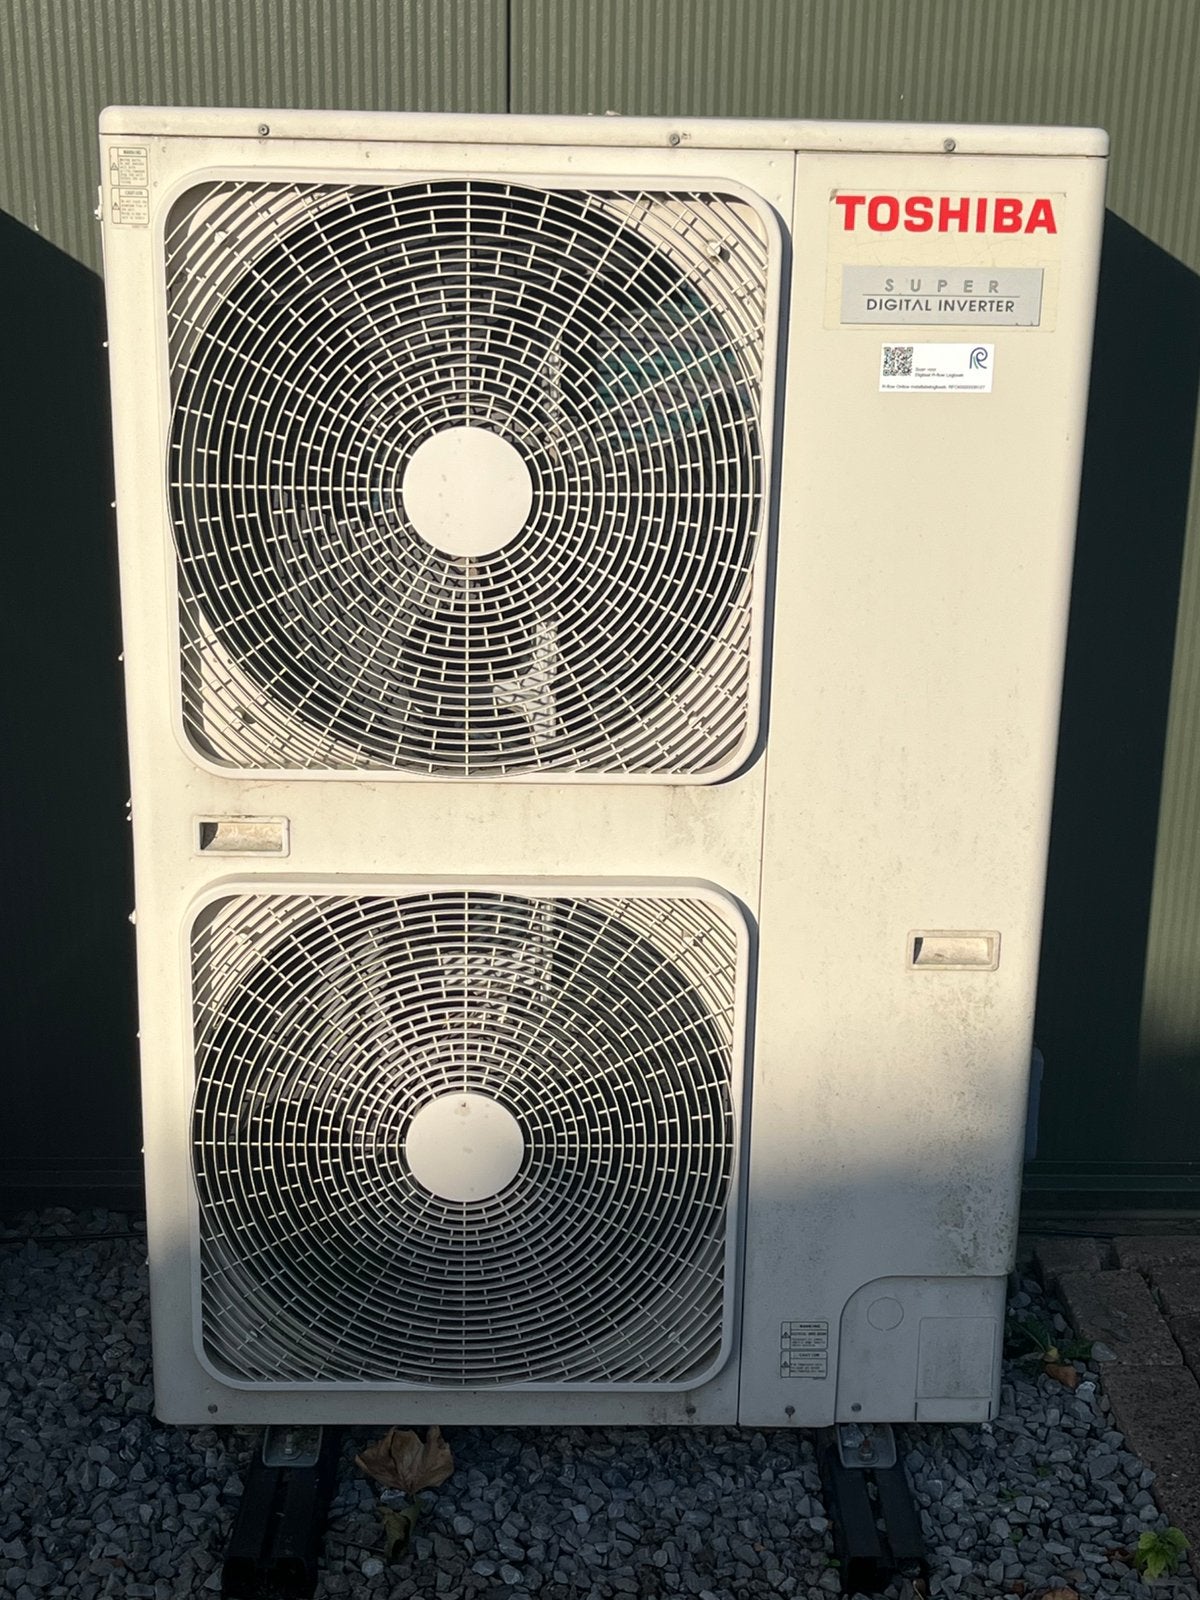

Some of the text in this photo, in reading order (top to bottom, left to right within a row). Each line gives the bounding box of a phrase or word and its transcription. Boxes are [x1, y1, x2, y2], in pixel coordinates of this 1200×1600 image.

[836, 195, 1057, 234] TOSHIBA
[885, 279, 999, 293] SUPER
[866, 298, 1015, 313] DIGITAL INVERTER
